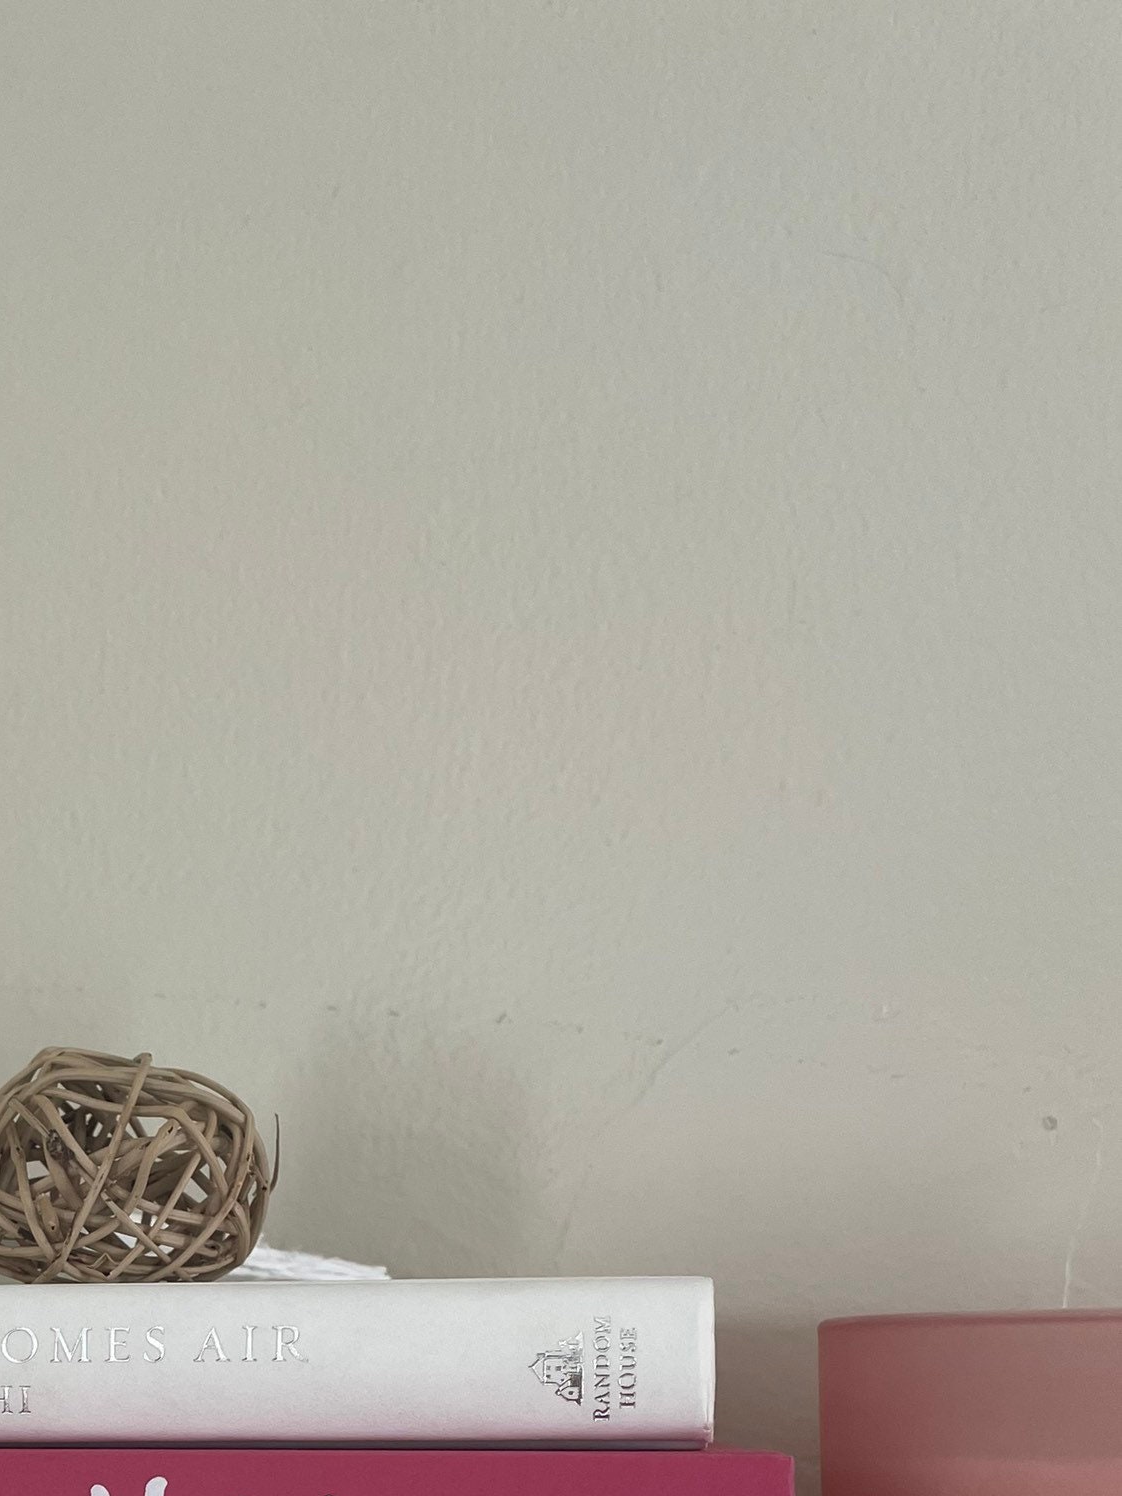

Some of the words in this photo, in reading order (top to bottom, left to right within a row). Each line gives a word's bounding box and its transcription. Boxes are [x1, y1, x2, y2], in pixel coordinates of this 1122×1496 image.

[193, 1324, 309, 1365] AIR
[592, 1315, 613, 1422] RANDOM
[619, 1326, 638, 1410] HOUSE
